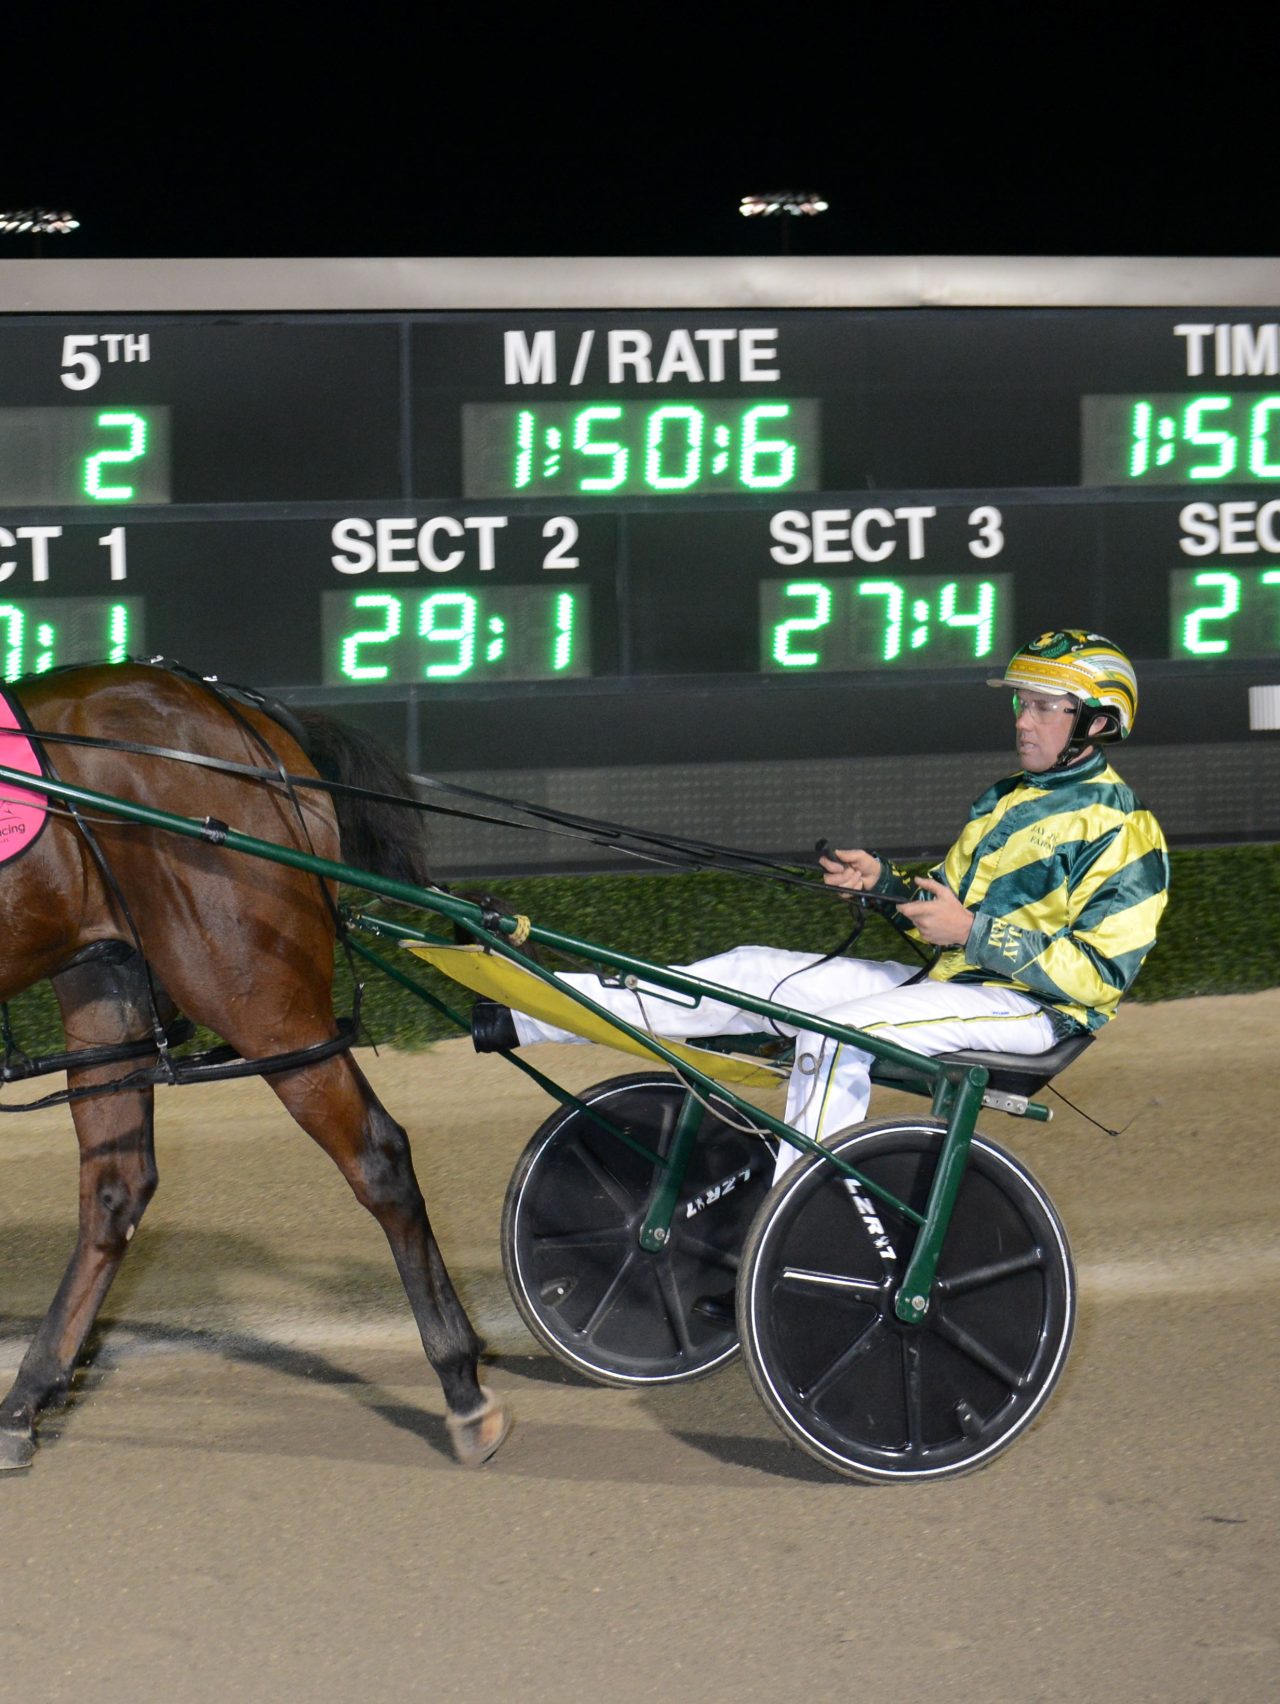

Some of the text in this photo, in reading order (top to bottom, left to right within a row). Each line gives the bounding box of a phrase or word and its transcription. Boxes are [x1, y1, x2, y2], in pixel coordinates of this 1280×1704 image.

[60, 333, 150, 391] 5TH
[1173, 323, 1280, 377] TIM
[82, 411, 149, 500] 2
[98, 526, 127, 581] 1
[331, 516, 580, 575] SECT 2
[769, 505, 1004, 565] SECT 3
